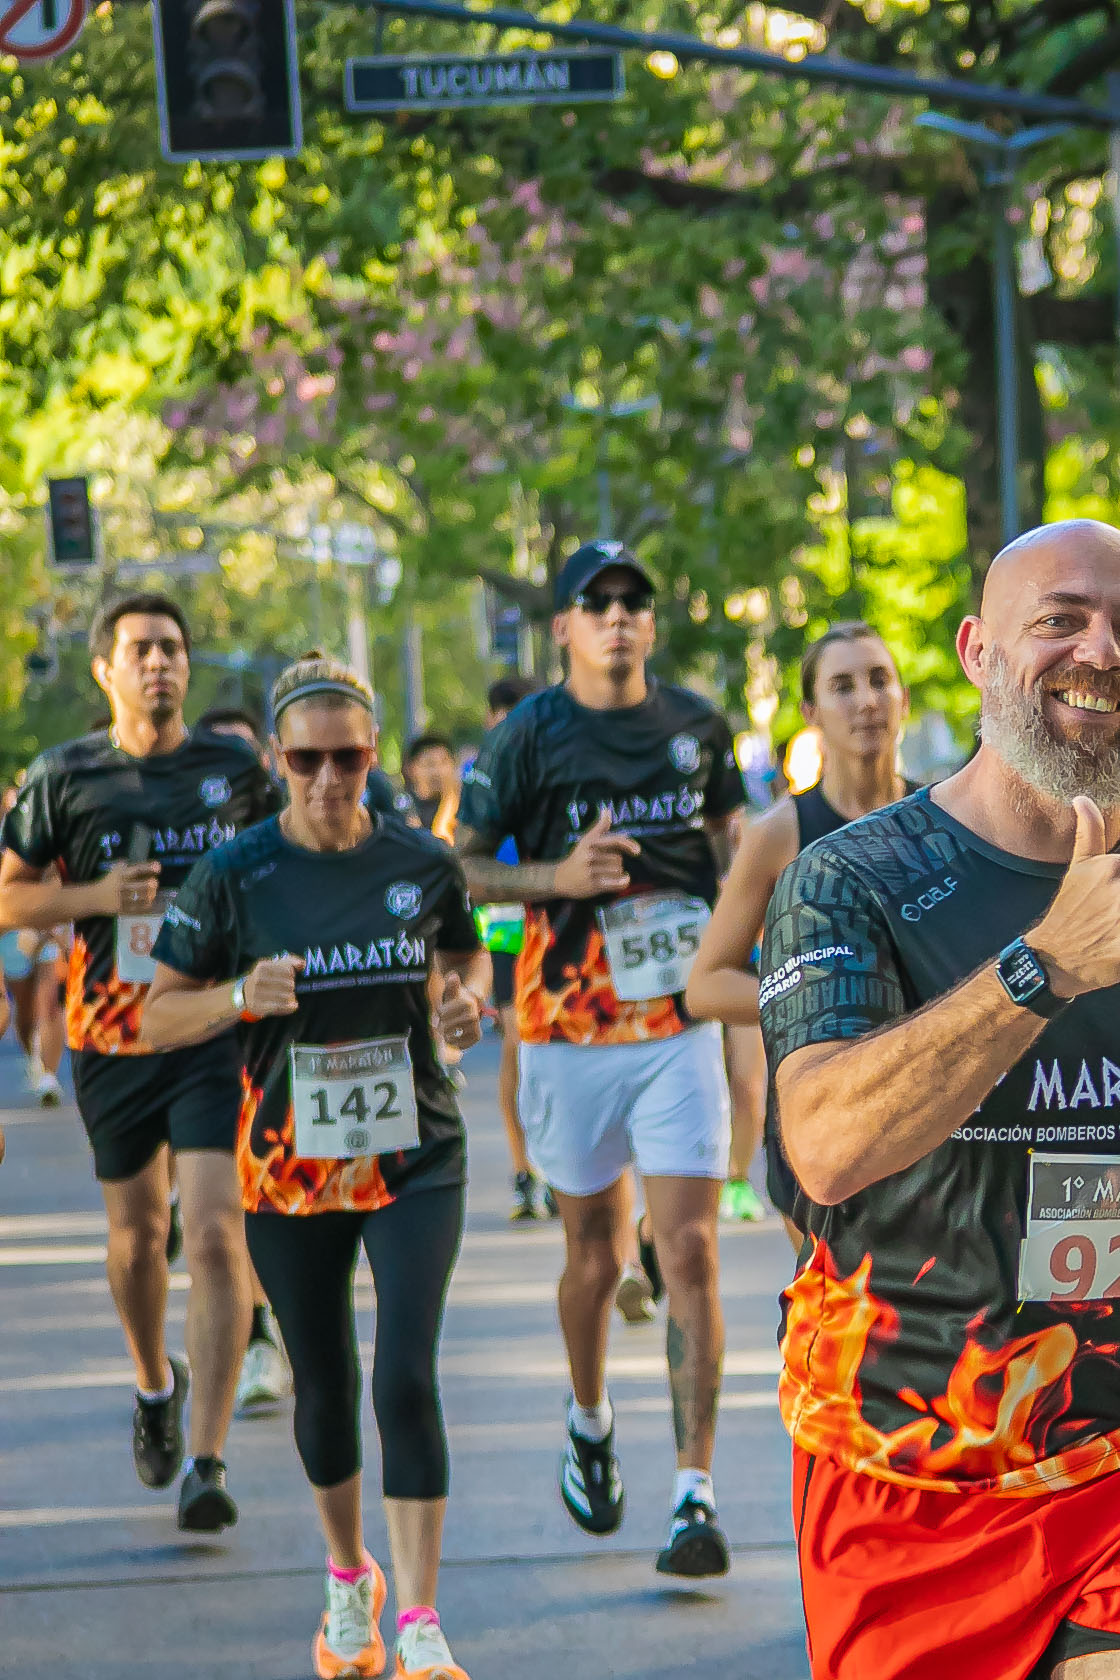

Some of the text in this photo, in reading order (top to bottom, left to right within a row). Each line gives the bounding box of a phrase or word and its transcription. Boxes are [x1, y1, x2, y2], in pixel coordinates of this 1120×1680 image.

[403, 53, 569, 98] TUCUMÁN
[304, 928, 427, 977] MARATÓN
[621, 921, 699, 969] 585
[784, 946, 854, 973] MUNICIPAL
[310, 1081, 402, 1126] 142
[1036, 1124, 1116, 1142] BOMBEROS
[1039, 1206, 1091, 1219] ASOCIACIÓN
